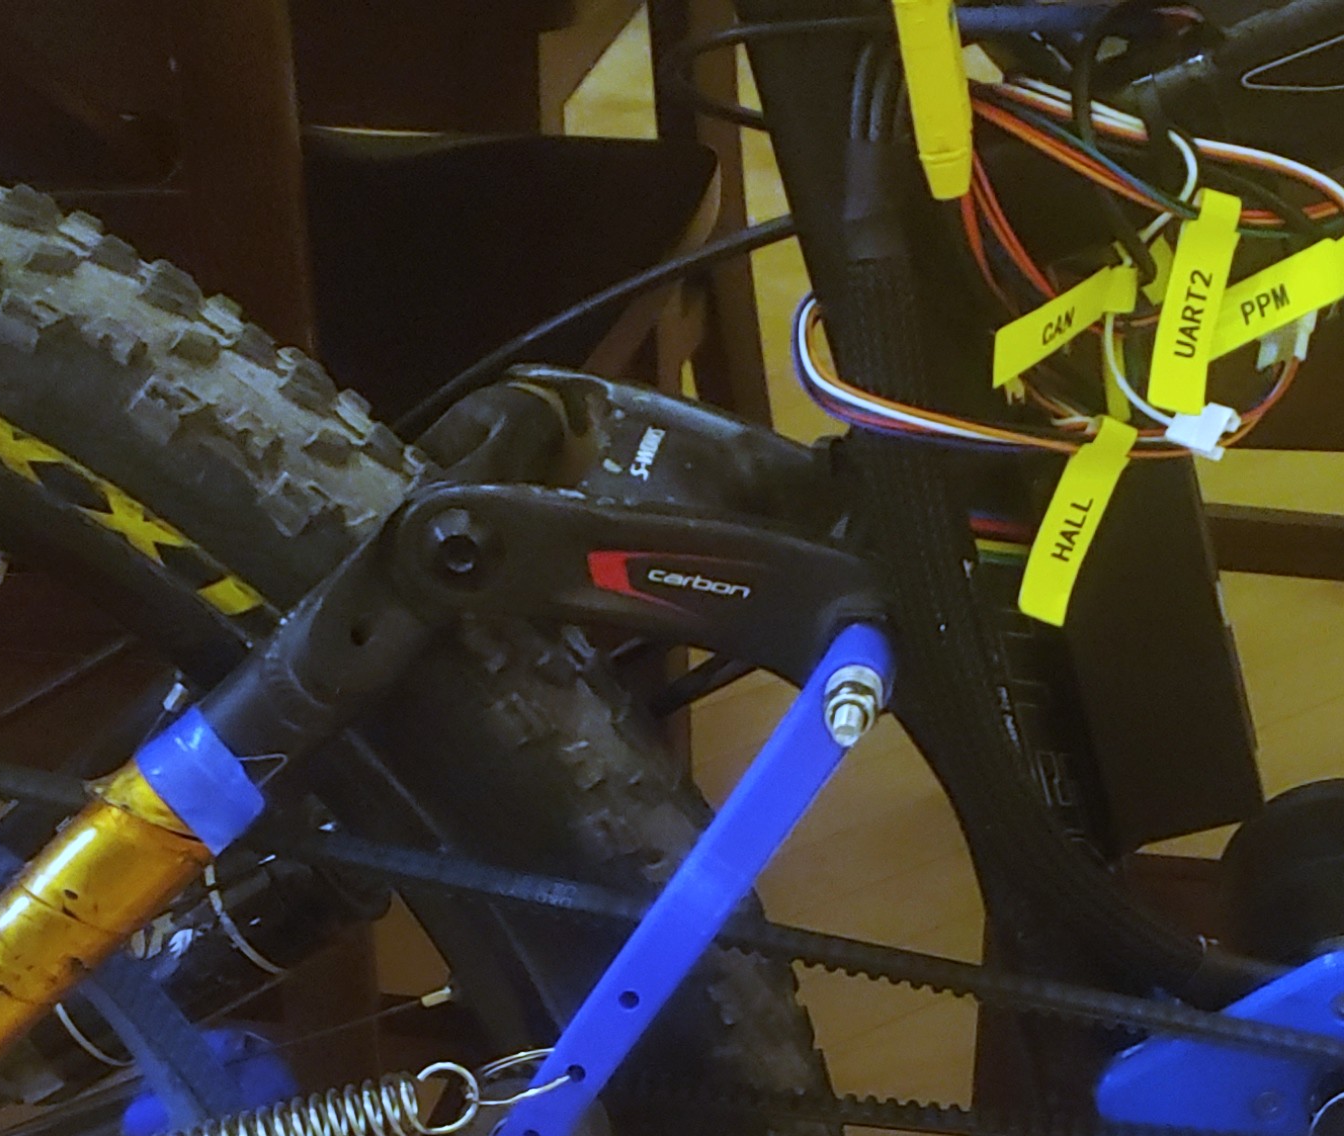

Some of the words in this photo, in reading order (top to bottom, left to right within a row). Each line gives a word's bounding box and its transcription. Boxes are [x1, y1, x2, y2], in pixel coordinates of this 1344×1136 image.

[1173, 269, 1214, 359] UART2
[1240, 283, 1291, 326] PPM
[1041, 306, 1077, 347] CAN
[1049, 495, 1095, 564] HALL
[647, 568, 752, 600] carbon
